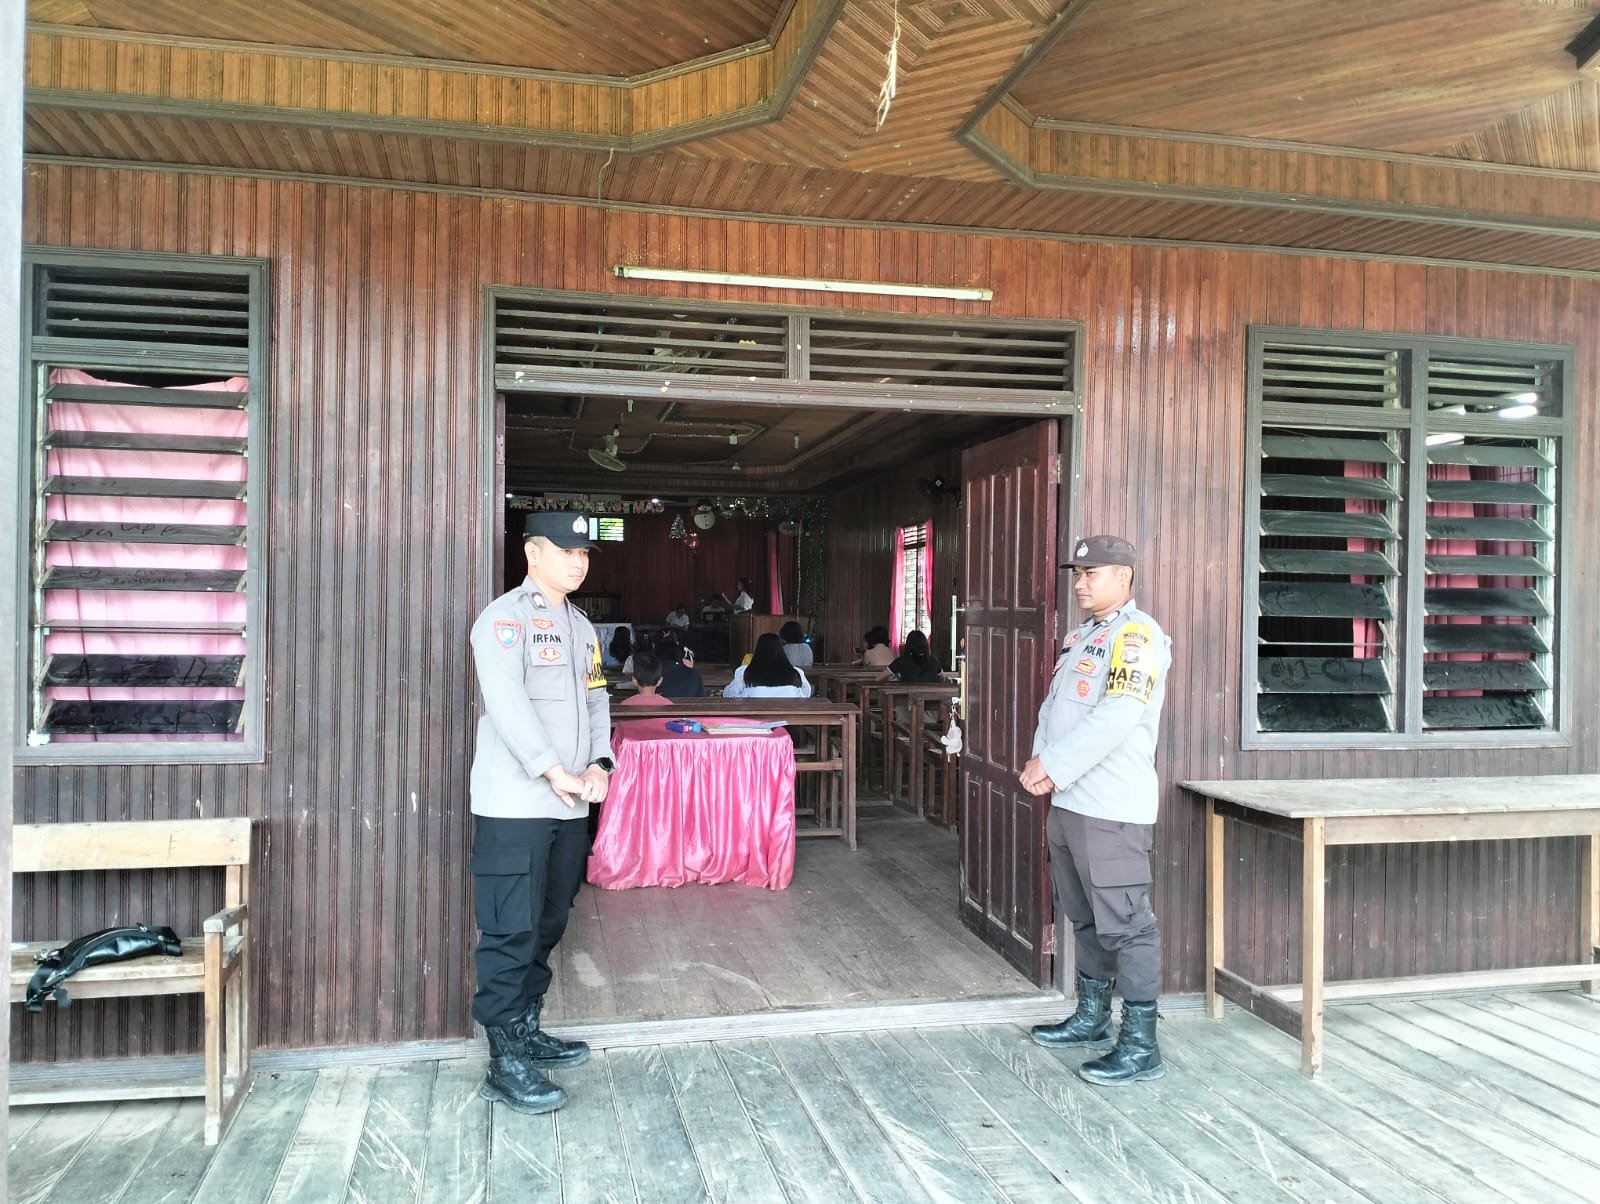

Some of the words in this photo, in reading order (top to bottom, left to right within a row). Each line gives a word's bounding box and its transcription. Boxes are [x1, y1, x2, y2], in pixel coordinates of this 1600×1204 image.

[509, 496, 569, 512] MERRY
[533, 633, 562, 644] IRFAN
[1083, 645, 1105, 658] POLRI
